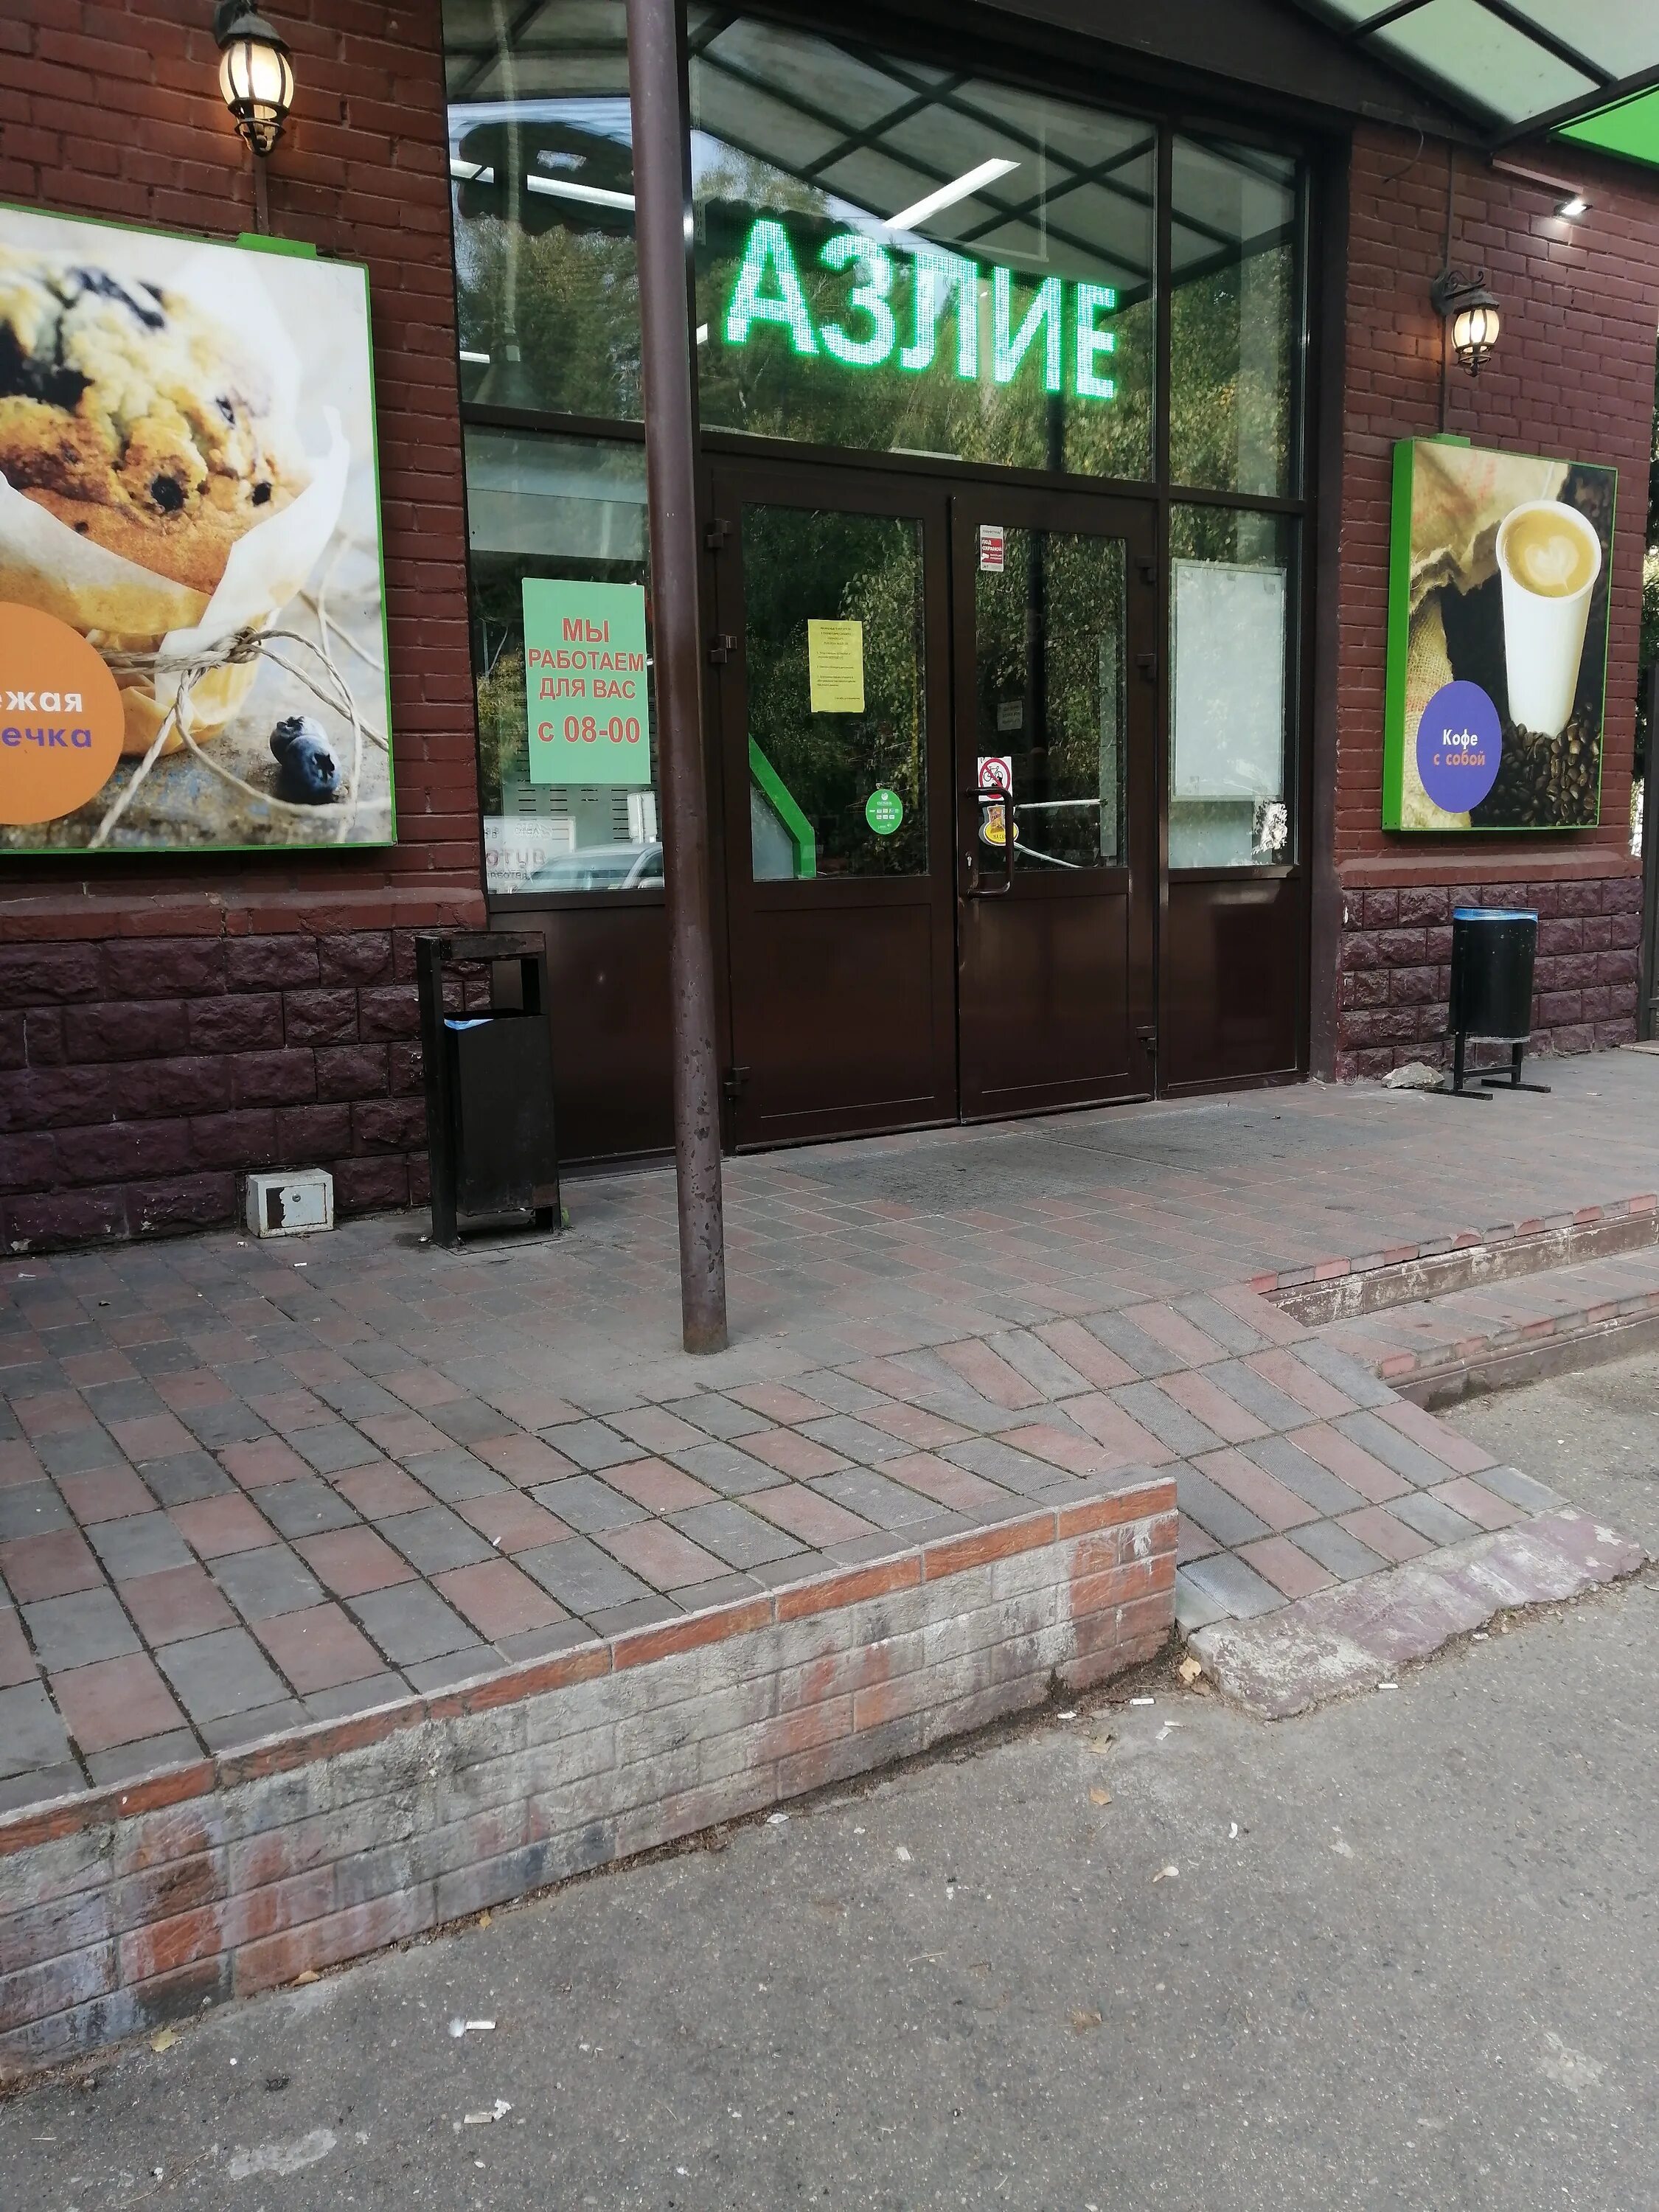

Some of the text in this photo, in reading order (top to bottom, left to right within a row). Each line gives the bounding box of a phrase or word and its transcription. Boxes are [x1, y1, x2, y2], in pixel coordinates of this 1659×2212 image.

[562, 618, 610, 643] МЫ
[528, 648, 644, 672] РАБОТАЕМ
[538, 677, 636, 700] ДЛЯ ВАС
[0, 691, 83, 712] жая
[1, 726, 92, 748] ечка
[563, 715, 640, 744] 08-00
[1443, 728, 1478, 750] Кофе
[1433, 749, 1486, 766] с собой
